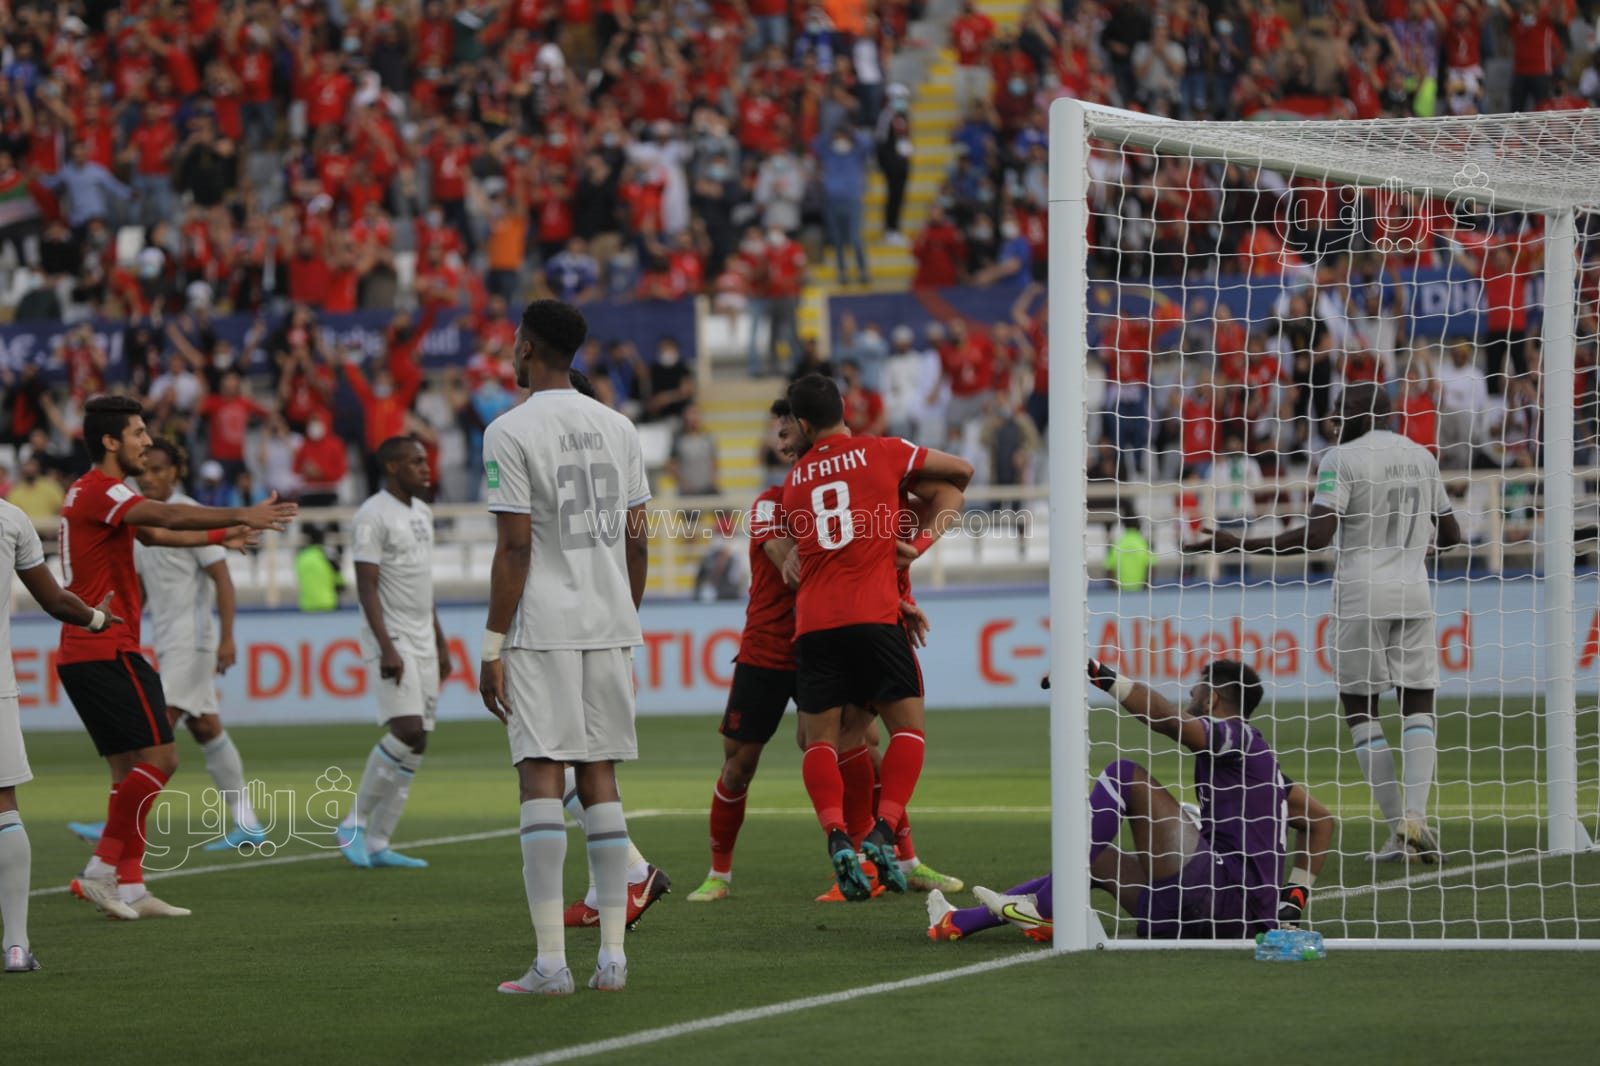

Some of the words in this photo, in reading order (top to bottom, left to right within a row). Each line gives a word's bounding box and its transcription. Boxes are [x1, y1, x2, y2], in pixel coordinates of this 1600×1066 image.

[791, 448, 867, 486] H.FATHY
[1385, 464, 1420, 480] MAGA
[811, 480, 855, 550] 8
[1384, 486, 1421, 549] 17
[248, 635, 481, 699] DIGA
